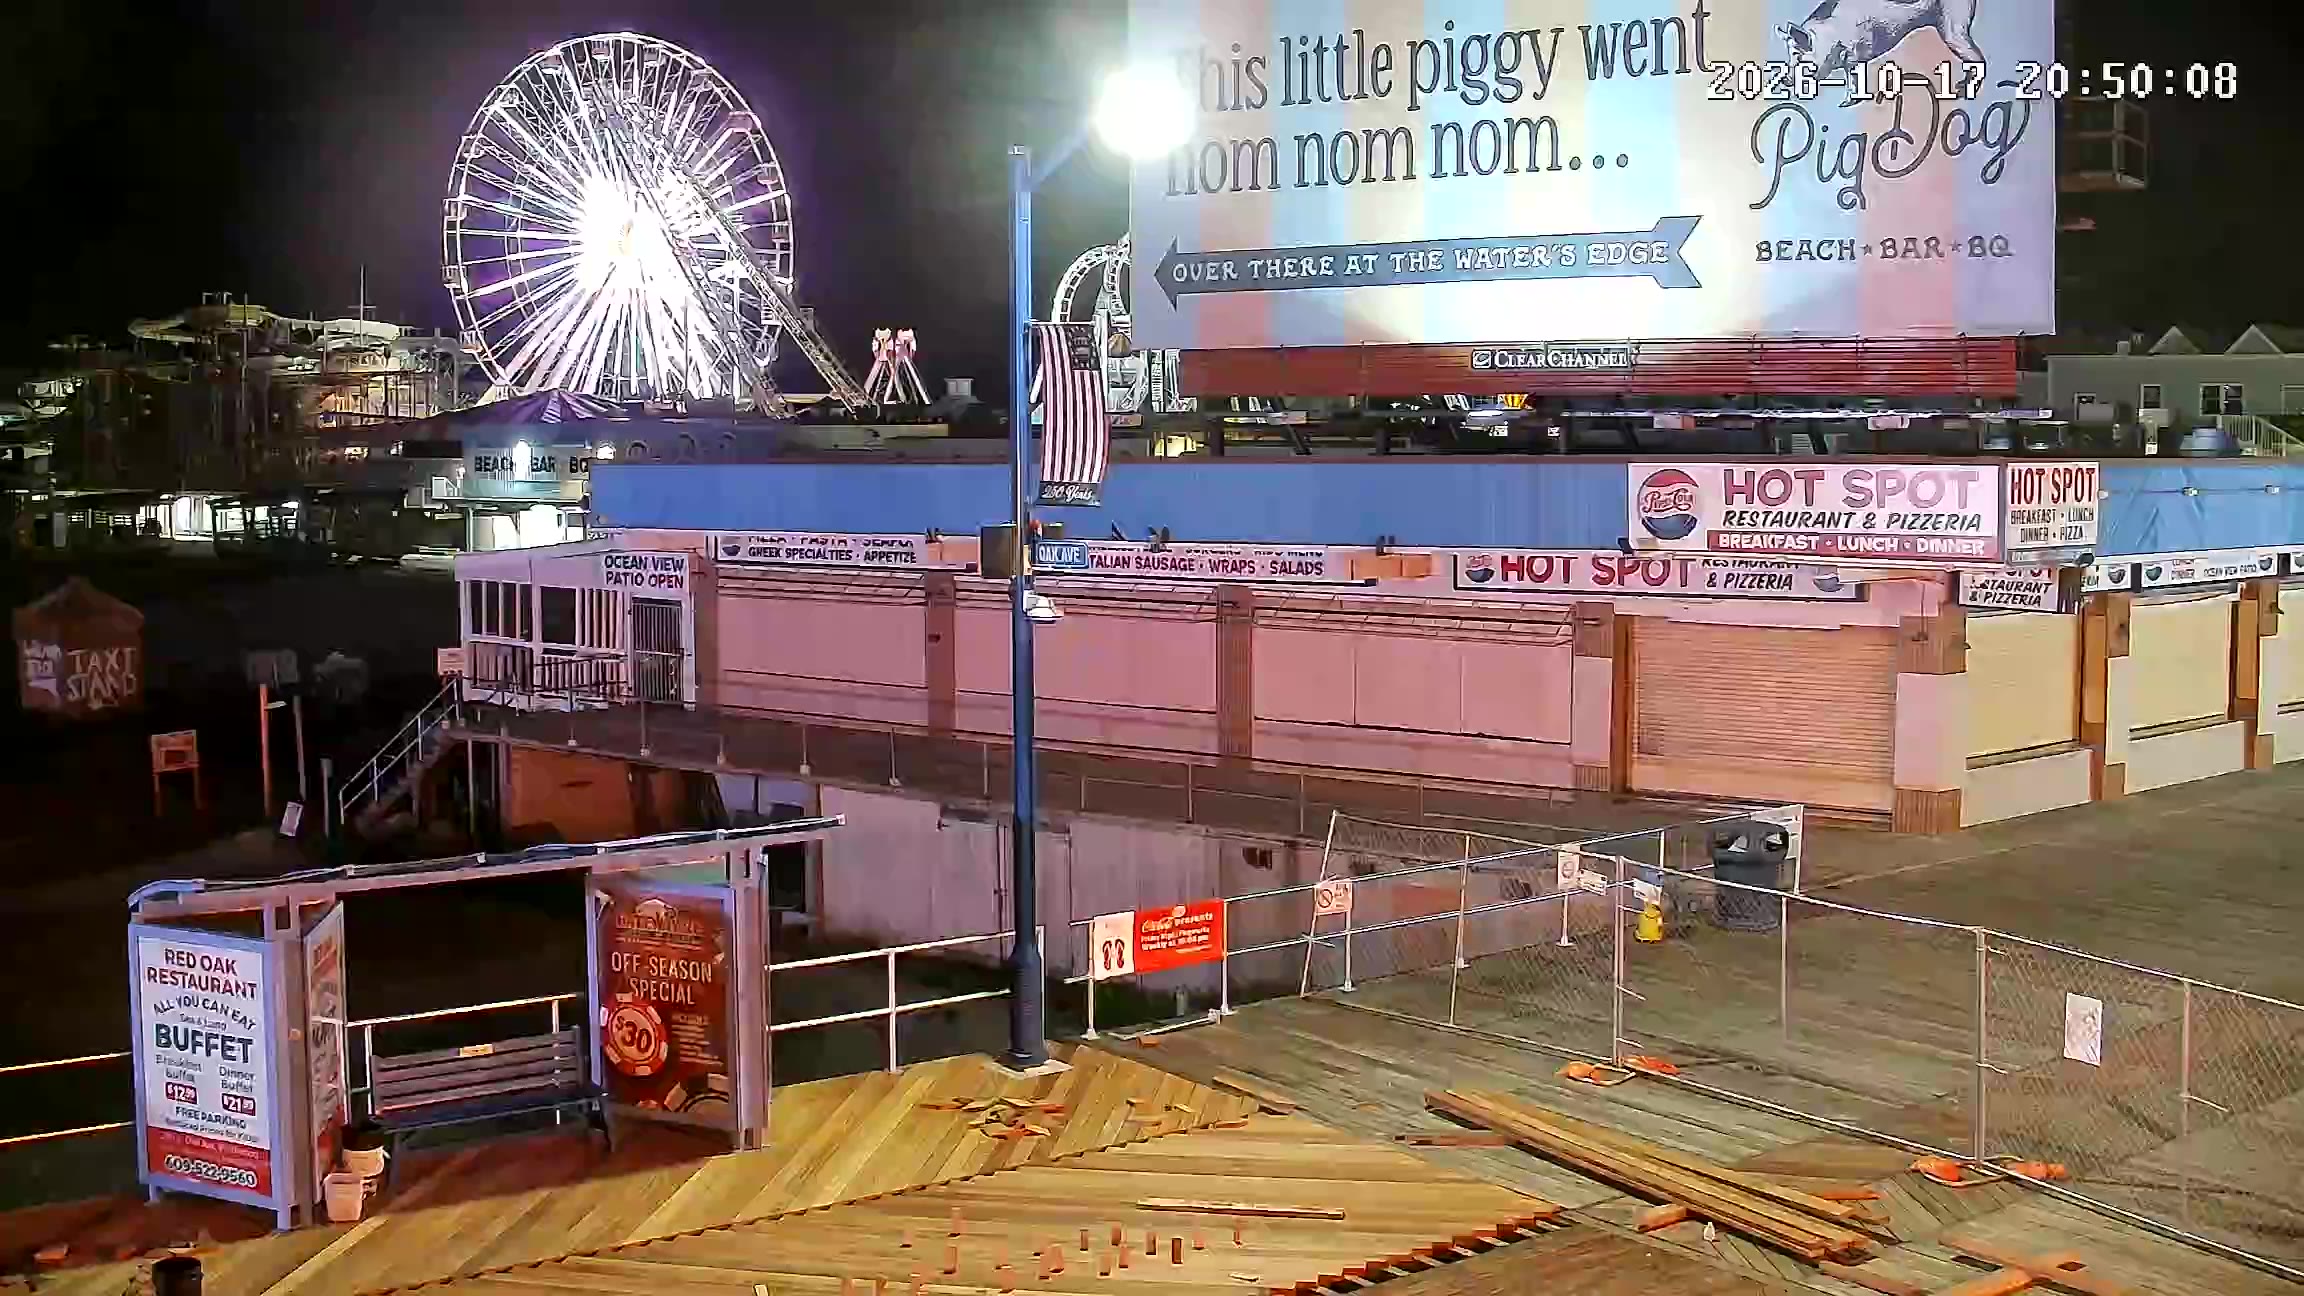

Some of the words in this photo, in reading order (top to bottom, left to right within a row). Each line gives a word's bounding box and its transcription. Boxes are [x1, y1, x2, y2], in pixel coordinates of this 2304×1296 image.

[1178, 40, 1268, 112] his
[1280, 30, 1393, 107] little
[1407, 20, 1564, 110] piggy
[1578, 0, 1711, 81] went
[1164, 136, 1281, 197] nom
[1293, 124, 1416, 188] nom
[1430, 115, 1629, 179] nom...
[1755, 238, 1857, 262] BEACH
[1880, 237, 1946, 261] BAR
[1968, 235, 2015, 259] BQ
[1172, 261, 1237, 283] OVER
[1247, 256, 1334, 281] THERE
[1344, 254, 1379, 277] AT
[1389, 250, 1444, 274] THE
[1454, 241, 1576, 271] WATER'S
[1587, 241, 1669, 266] EDGE
[531, 456, 556, 472] BAR
[1042, 485, 1064, 499] 250
[1066, 485, 1093, 502] Years
[1722, 469, 1824, 507] HOT
[1842, 471, 1979, 510] SPOT
[2011, 468, 2045, 504] HOT
[2051, 467, 2096, 504] SPOT
[1722, 511, 1853, 530] RESTAURANT
[1863, 512, 1877, 529] &
[1887, 513, 1981, 532] PIZZERIA
[2011, 508, 2056, 525] BREAKFAST
[2067, 505, 2094, 522] LUNCH
[1719, 533, 1820, 552] BREAKFAST
[1836, 535, 1899, 553] LUNCH
[1916, 538, 1985, 557] DINNER
[2020, 526, 2049, 543] DINNER
[2059, 525, 2085, 541] PIZZA
[605, 555, 648, 569] OCEAN
[653, 557, 684, 571] VIEW
[748, 547, 781, 557] GREEK
[785, 548, 853, 560] SPECIALTIES
[1088, 554, 1130, 568] TALIAN
[1134, 556, 1195, 571] SAUSAGE
[1208, 558, 1256, 574] WRAPS
[1270, 560, 1324, 575] SALADS
[606, 572, 644, 587] PATIO
[648, 574, 683, 588] OPEN
[1501, 555, 1577, 584] HOT
[1591, 556, 1695, 588] SPOT
[1706, 572, 1718, 588] &
[1724, 572, 1793, 590] PIZZERIA
[1984, 592, 2041, 606] PIZZERIA
[67, 648, 136, 673] TAXI
[164, 948, 197, 970] RED
[200, 954, 238, 976] OAK
[146, 967, 257, 1000] RESTAURANT
[630, 978, 695, 1005] SPECIAL
[153, 998, 173, 1016] ALL
[175, 995, 200, 1009] YOU
[201, 998, 229, 1017] CAN
[231, 1008, 257, 1031] EAT
[155, 1024, 254, 1064] BUFFET
[175, 1106, 200, 1120] FREE
[201, 1112, 246, 1129] PARKING
